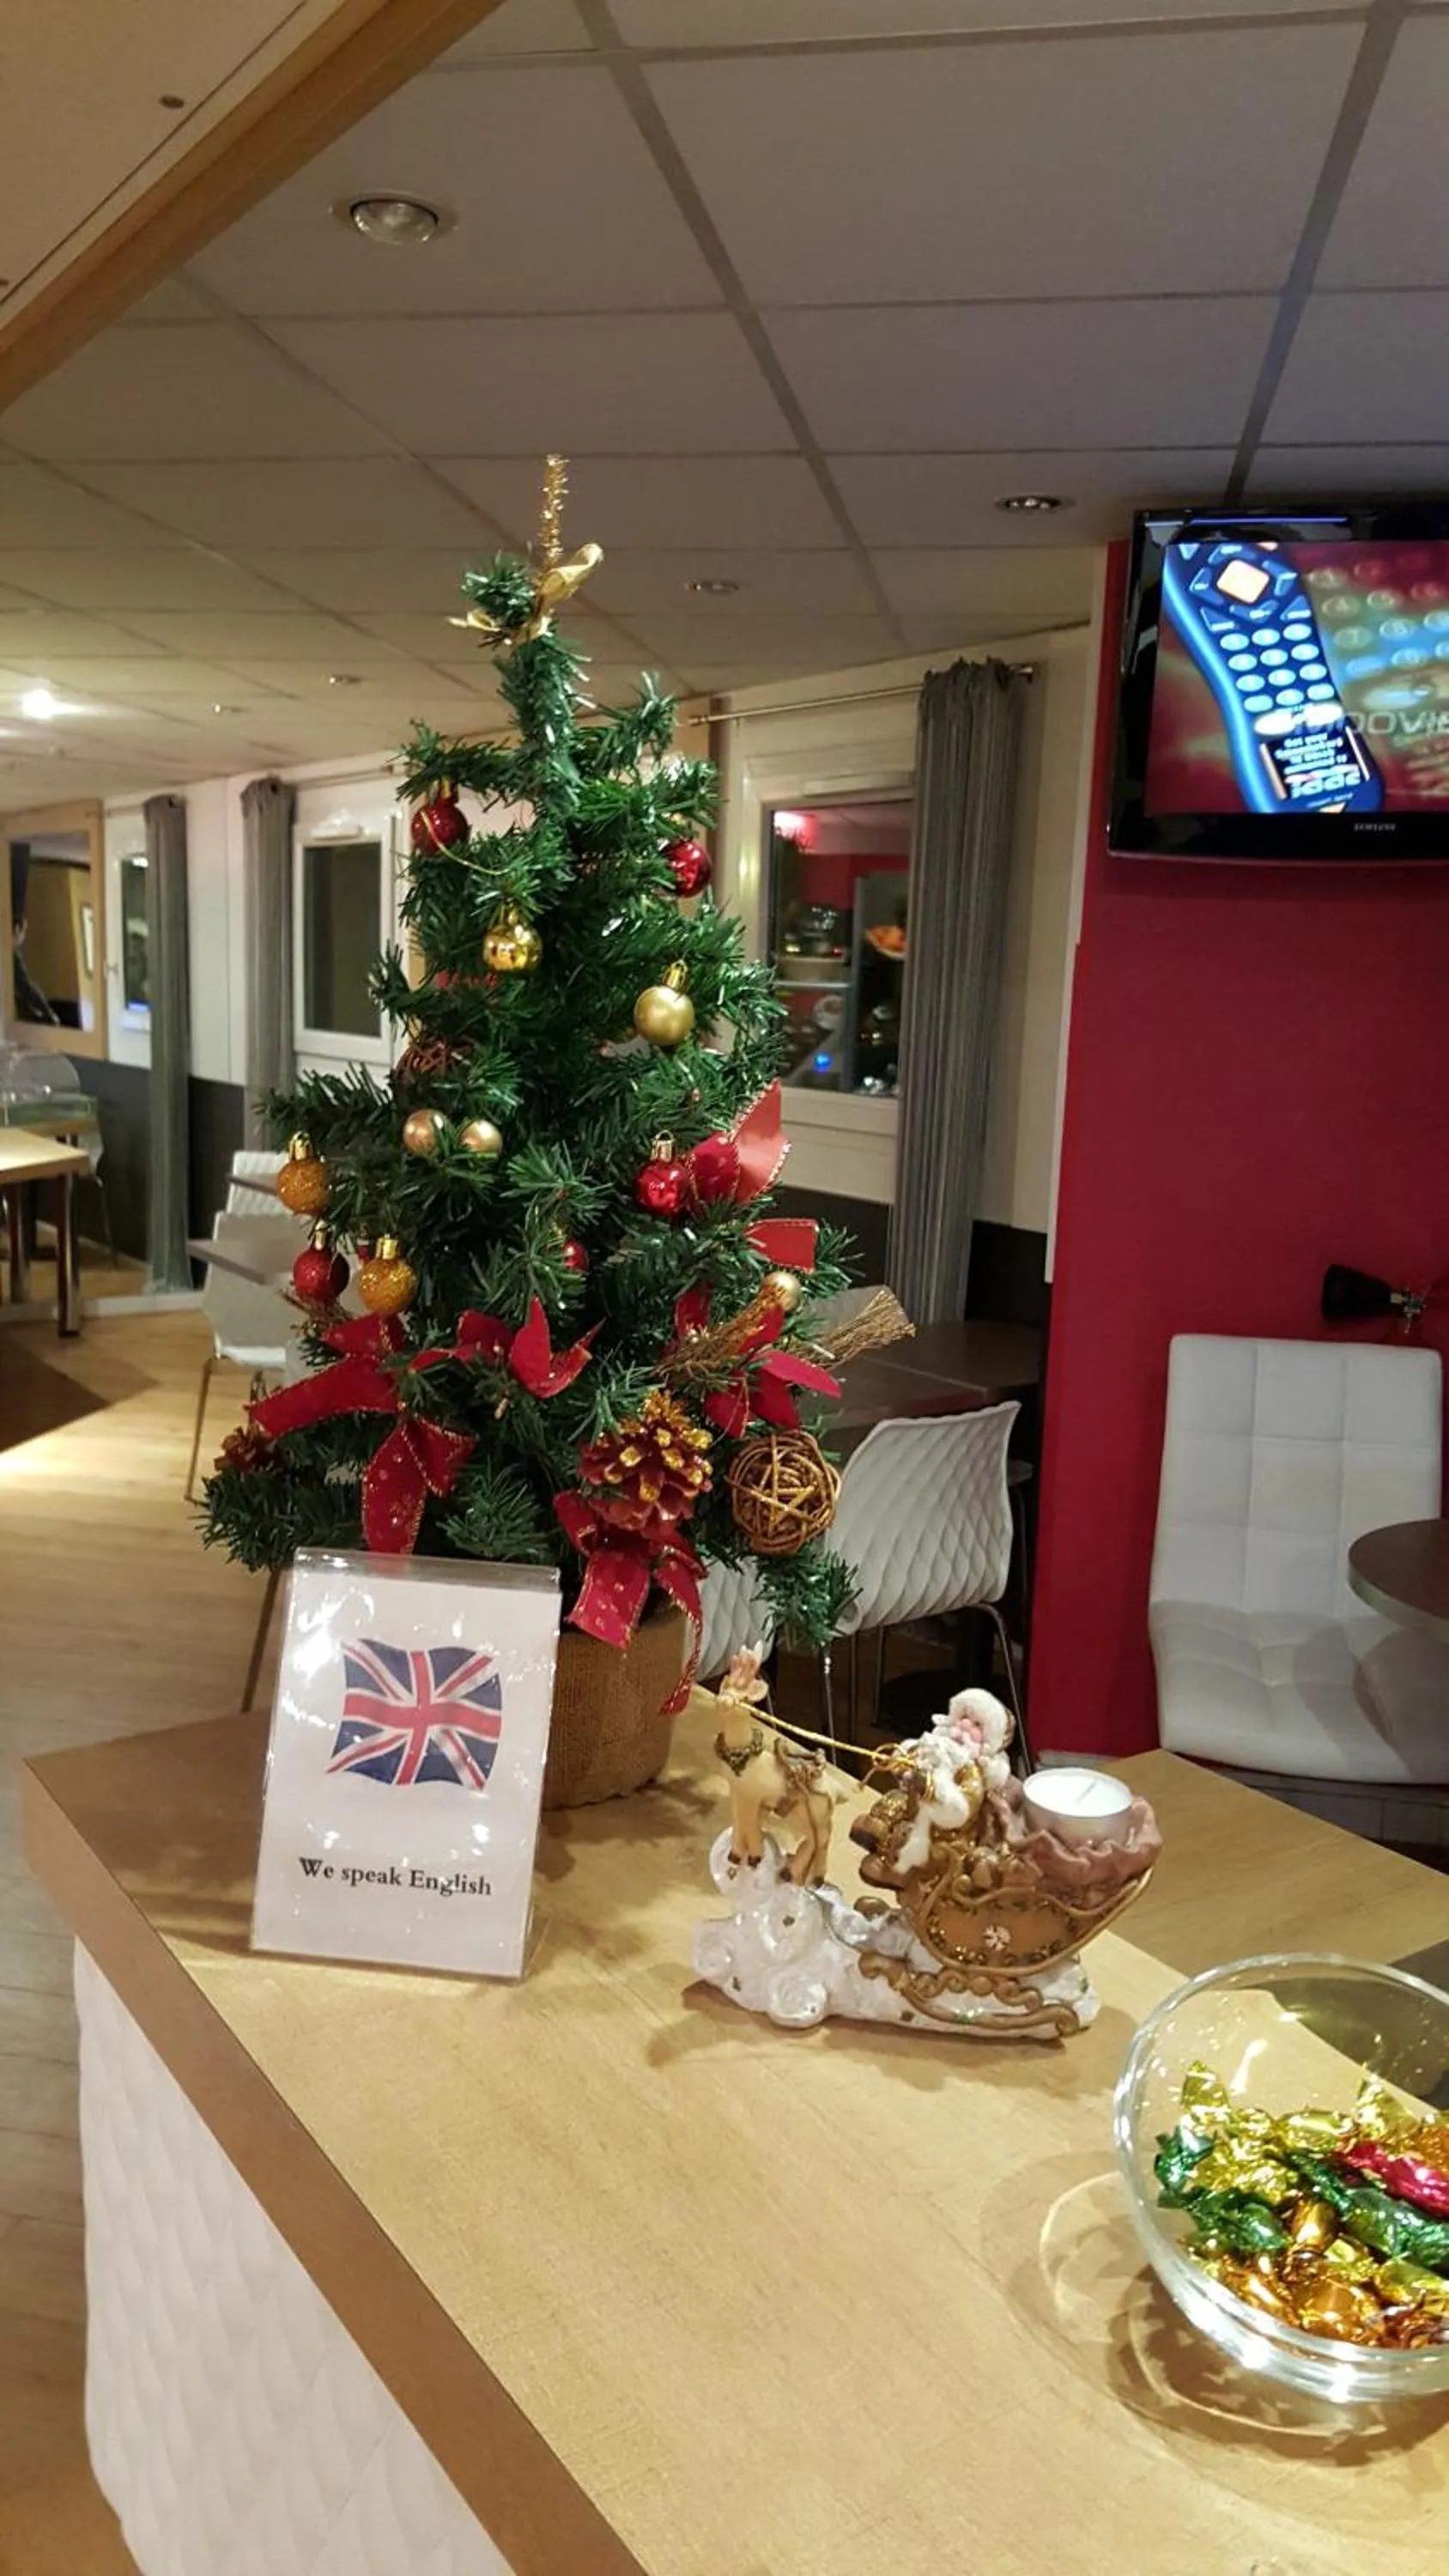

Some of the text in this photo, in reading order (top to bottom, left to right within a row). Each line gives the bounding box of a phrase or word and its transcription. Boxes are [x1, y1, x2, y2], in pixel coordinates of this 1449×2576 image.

[298, 1856, 493, 1897] We speak English
